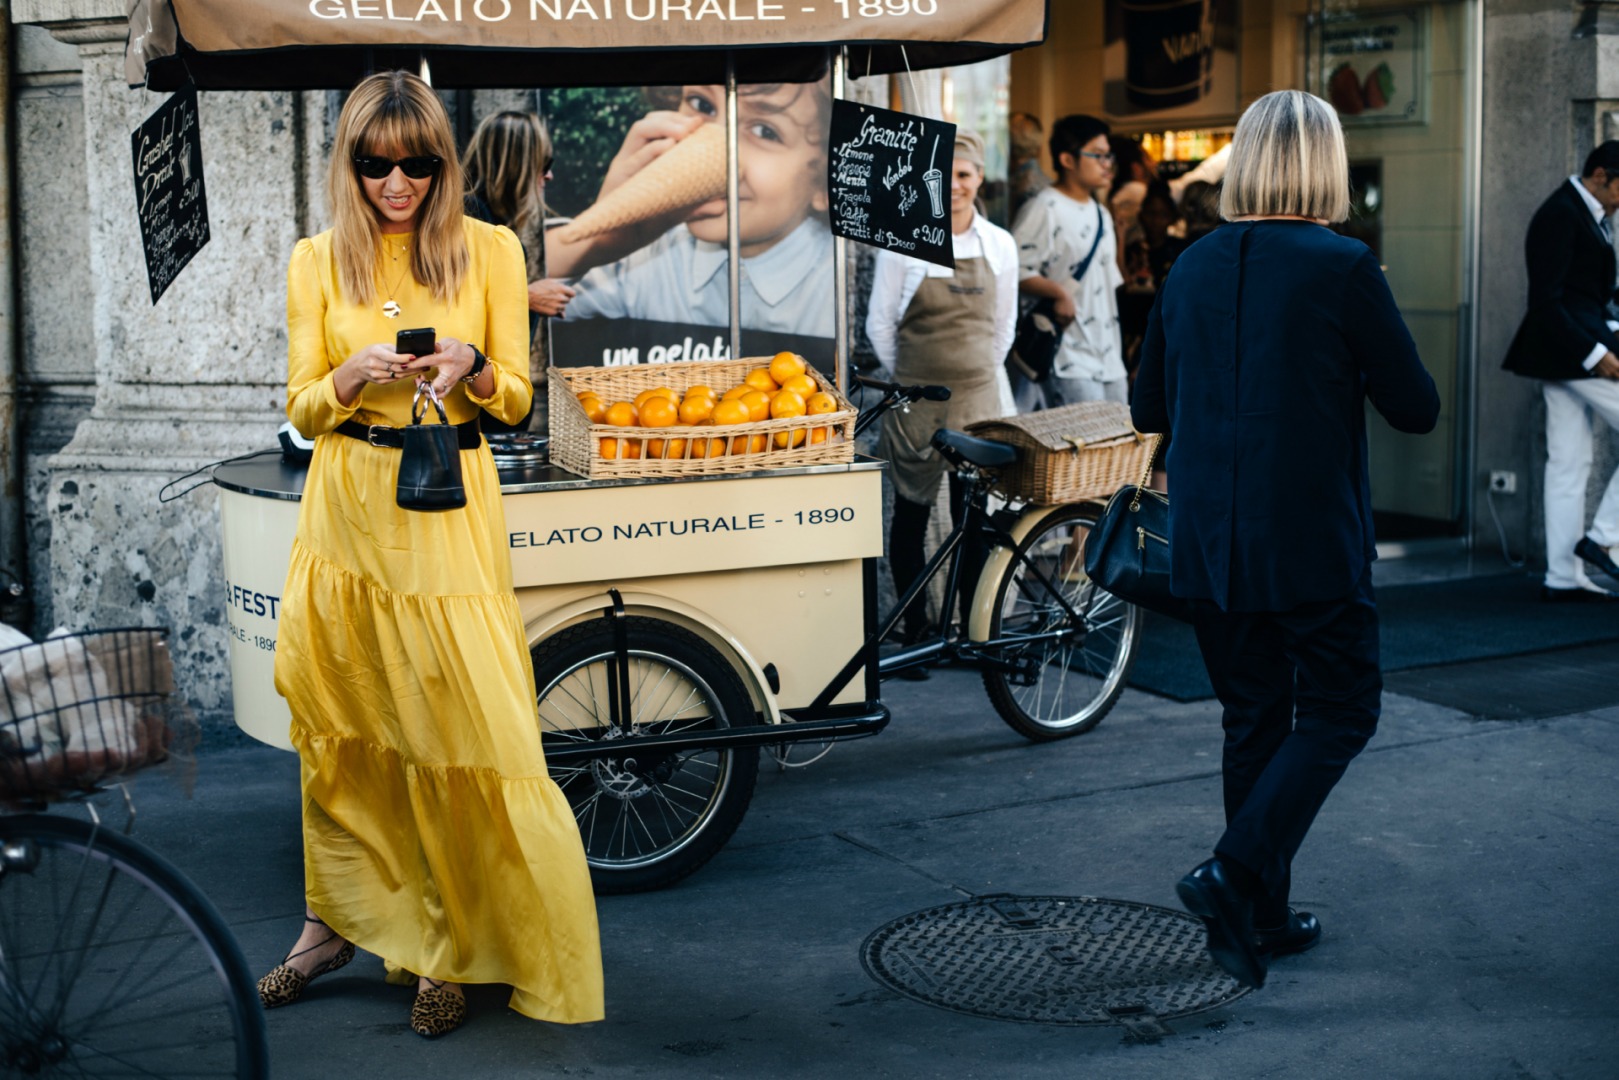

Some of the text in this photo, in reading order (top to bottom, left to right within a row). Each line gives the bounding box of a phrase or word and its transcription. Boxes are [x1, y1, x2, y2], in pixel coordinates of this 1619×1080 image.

[309, 0, 511, 21] GELATO
[530, 0, 785, 21] NATURALE
[834, 0, 938, 19] 1890
[178, 99, 194, 138] Ice
[852, 114, 918, 151] Granite
[140, 150, 174, 215] Drink
[837, 172, 867, 187] Menta
[838, 188, 871, 206] Fragola
[874, 228, 885, 243] di
[886, 231, 915, 250] Bosco
[603, 336, 731, 367] un gelat
[510, 526, 602, 549] ELATO
[613, 514, 765, 540] NATURALE
[794, 507, 855, 526] 1890
[233, 585, 282, 620] FEST
